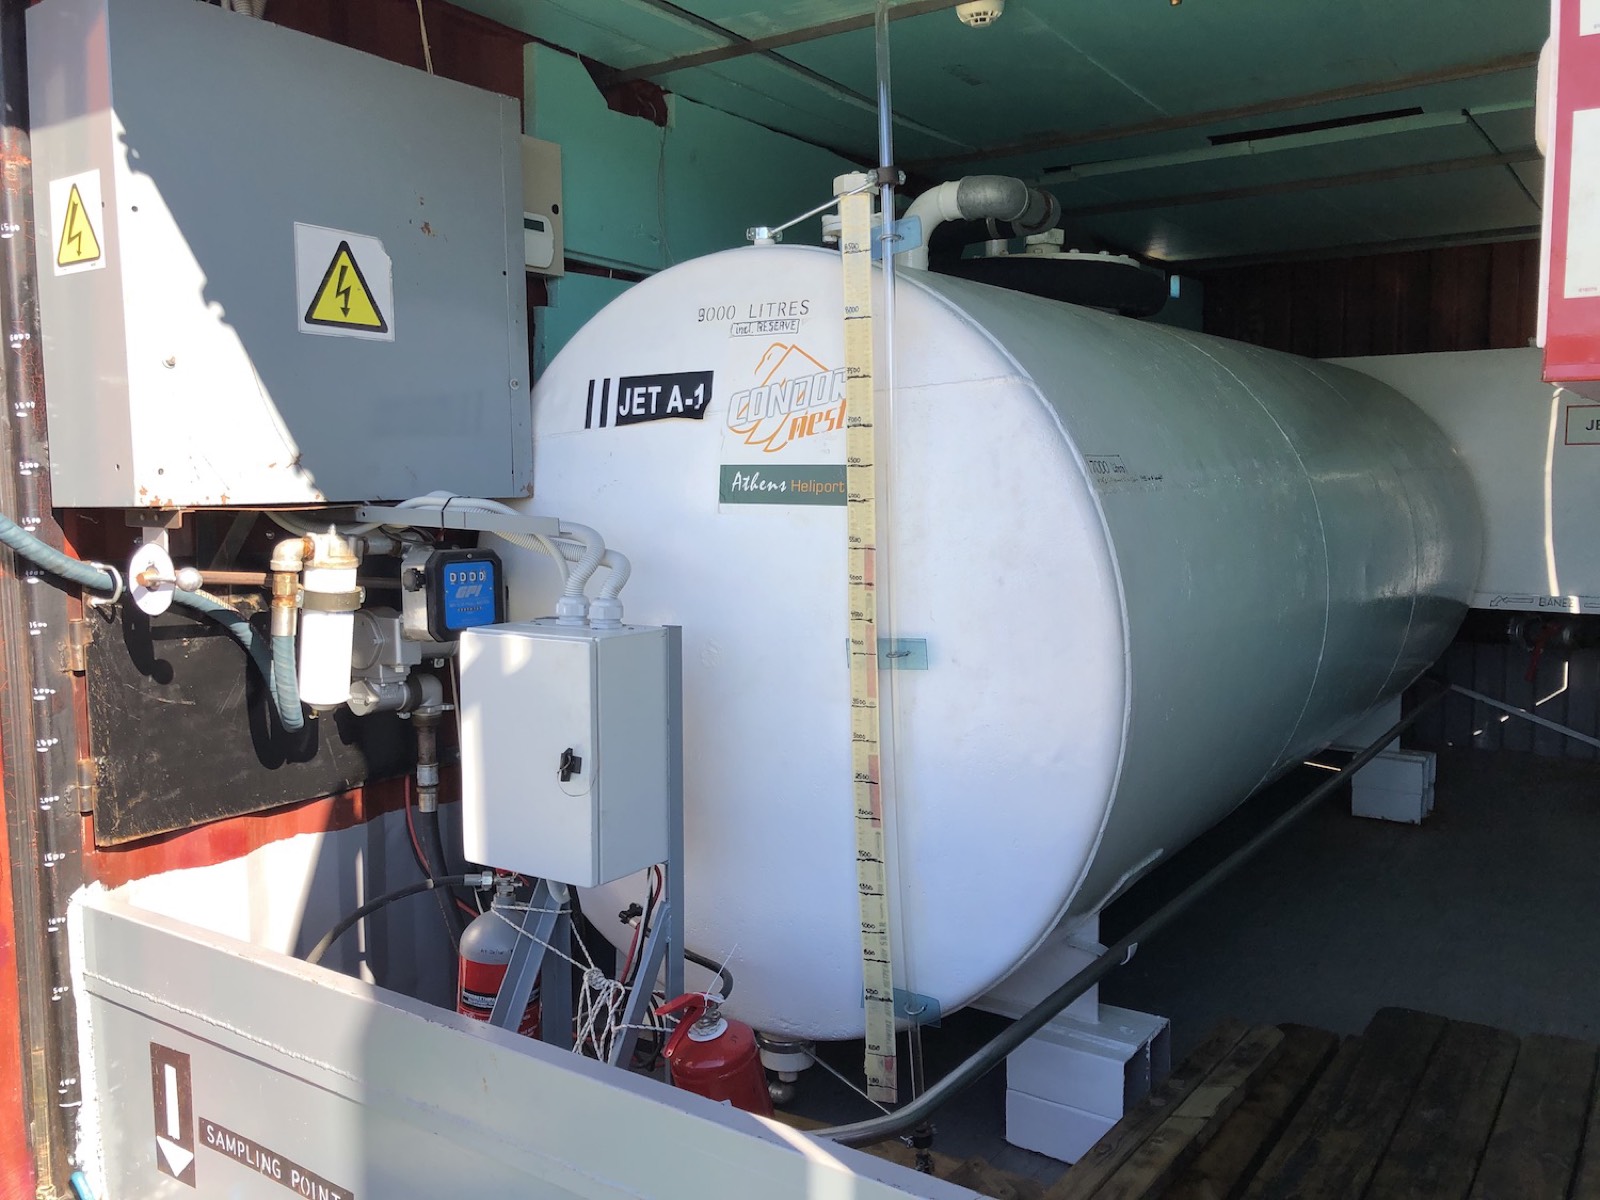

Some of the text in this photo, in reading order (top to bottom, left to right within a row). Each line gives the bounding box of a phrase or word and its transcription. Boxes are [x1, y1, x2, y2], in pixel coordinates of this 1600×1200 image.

[698, 300, 810, 322] 9000 LITRES
[757, 320, 796, 333] RESERVE
[619, 383, 704, 416] JET A-1
[732, 471, 845, 495] Athens Heliport
[60, 1078, 76, 1087] 100
[207, 1125, 281, 1179] SAMPLING
